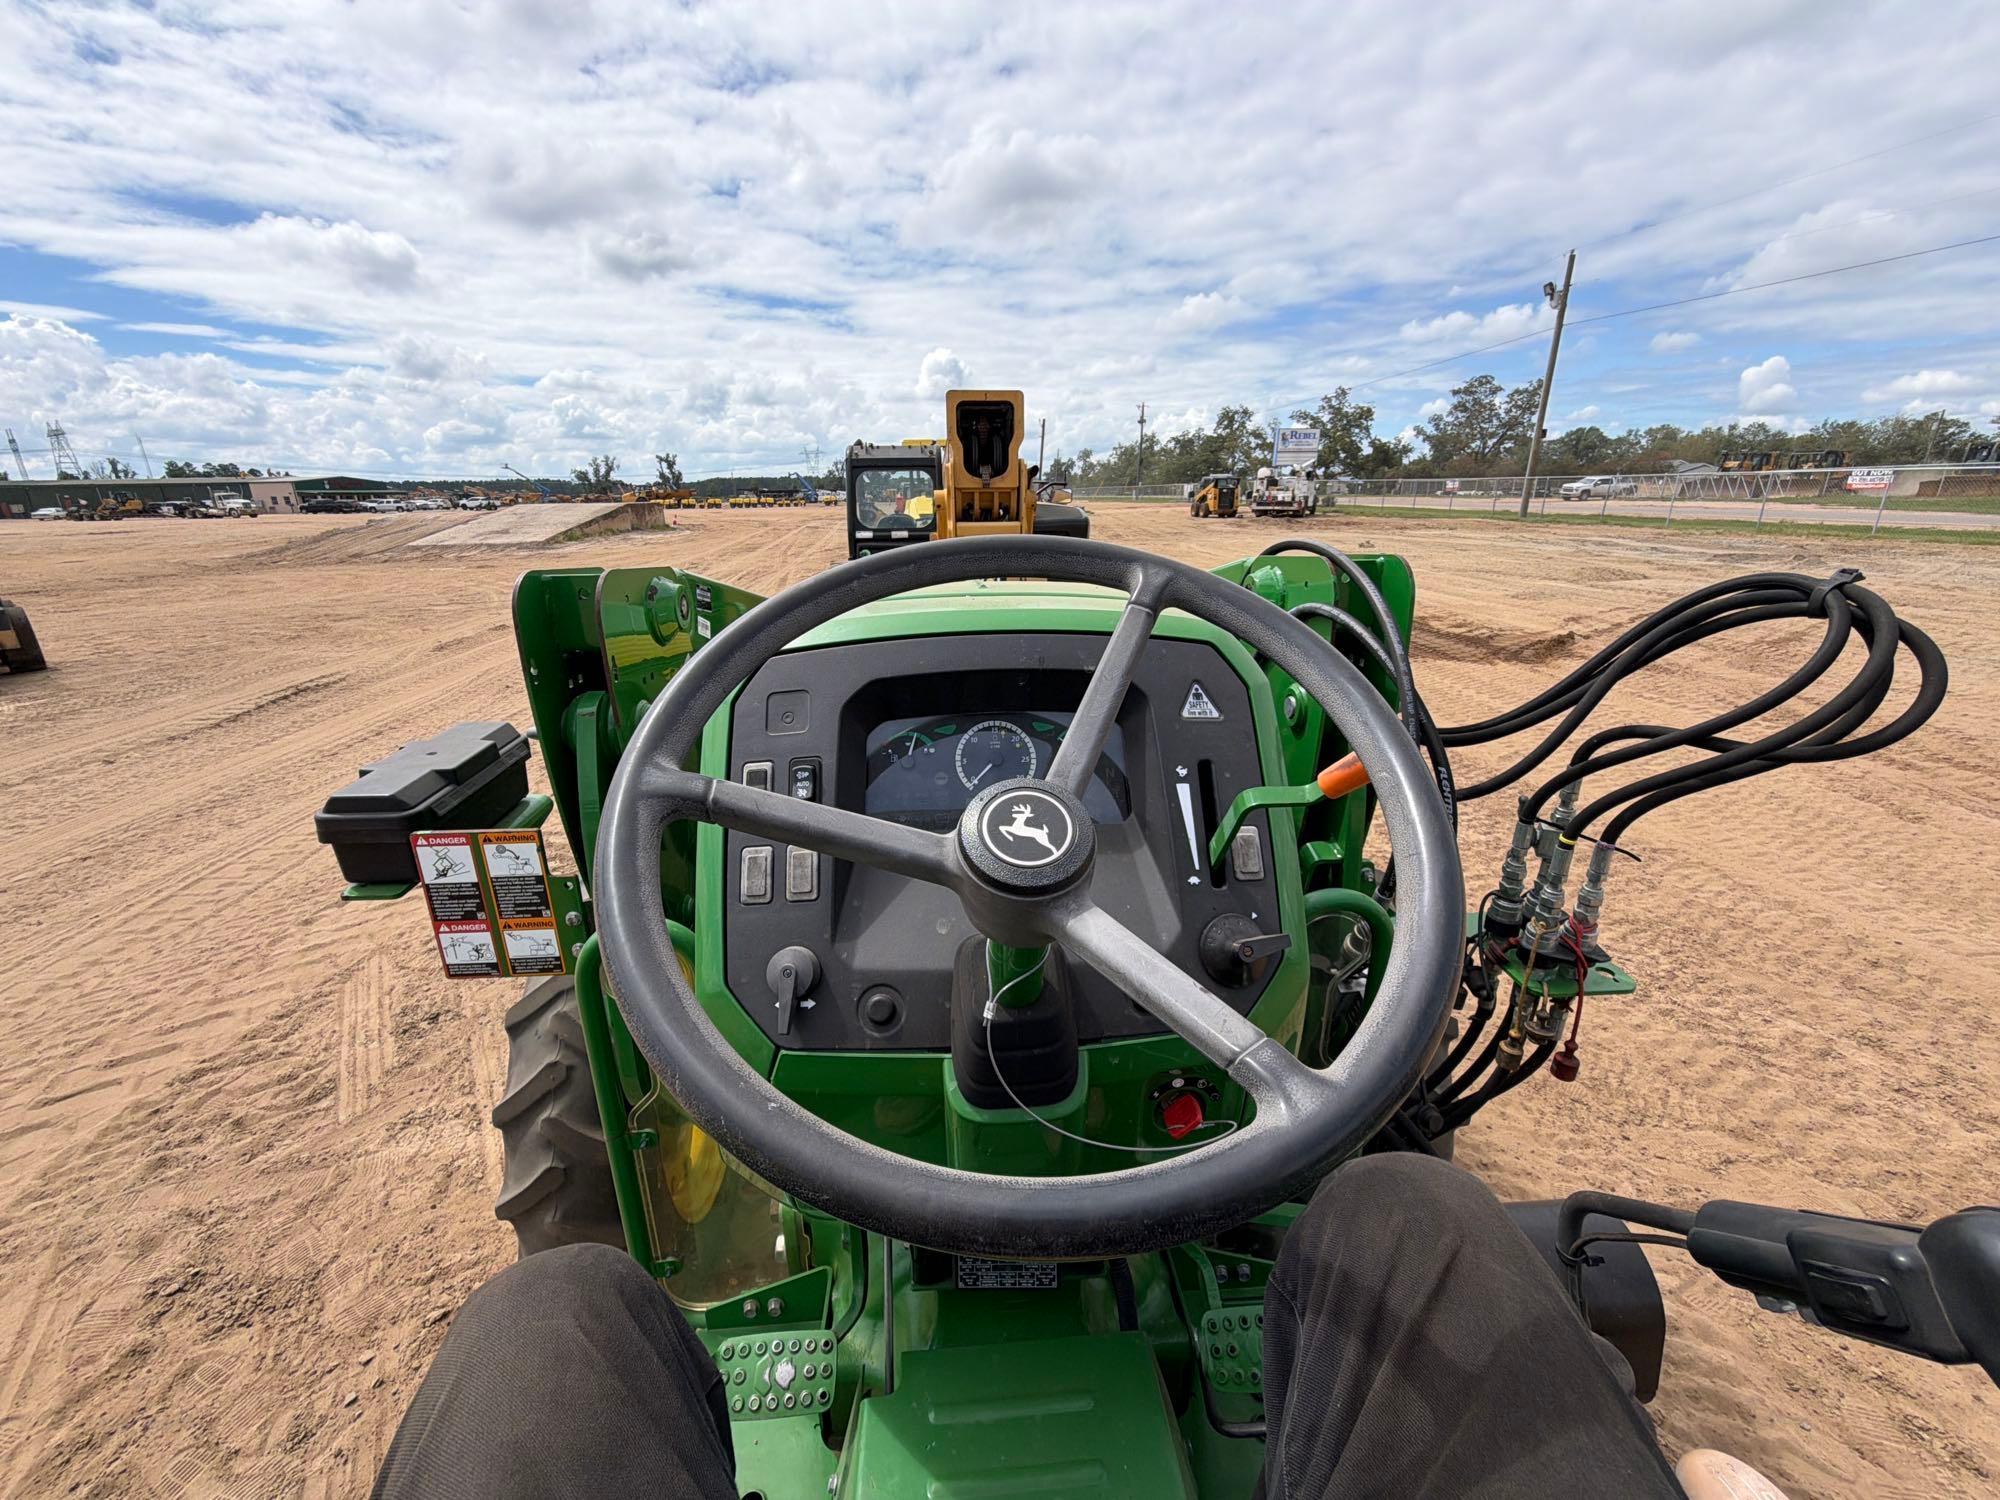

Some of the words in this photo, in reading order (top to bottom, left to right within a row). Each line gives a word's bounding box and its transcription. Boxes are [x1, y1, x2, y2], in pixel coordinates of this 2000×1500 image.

[1189, 701, 1208, 709] SAFETY
[429, 837, 467, 845] DANGER
[494, 834, 536, 842] WARNING
[451, 923, 487, 931] DANGER
[513, 921, 554, 929] WARNING
